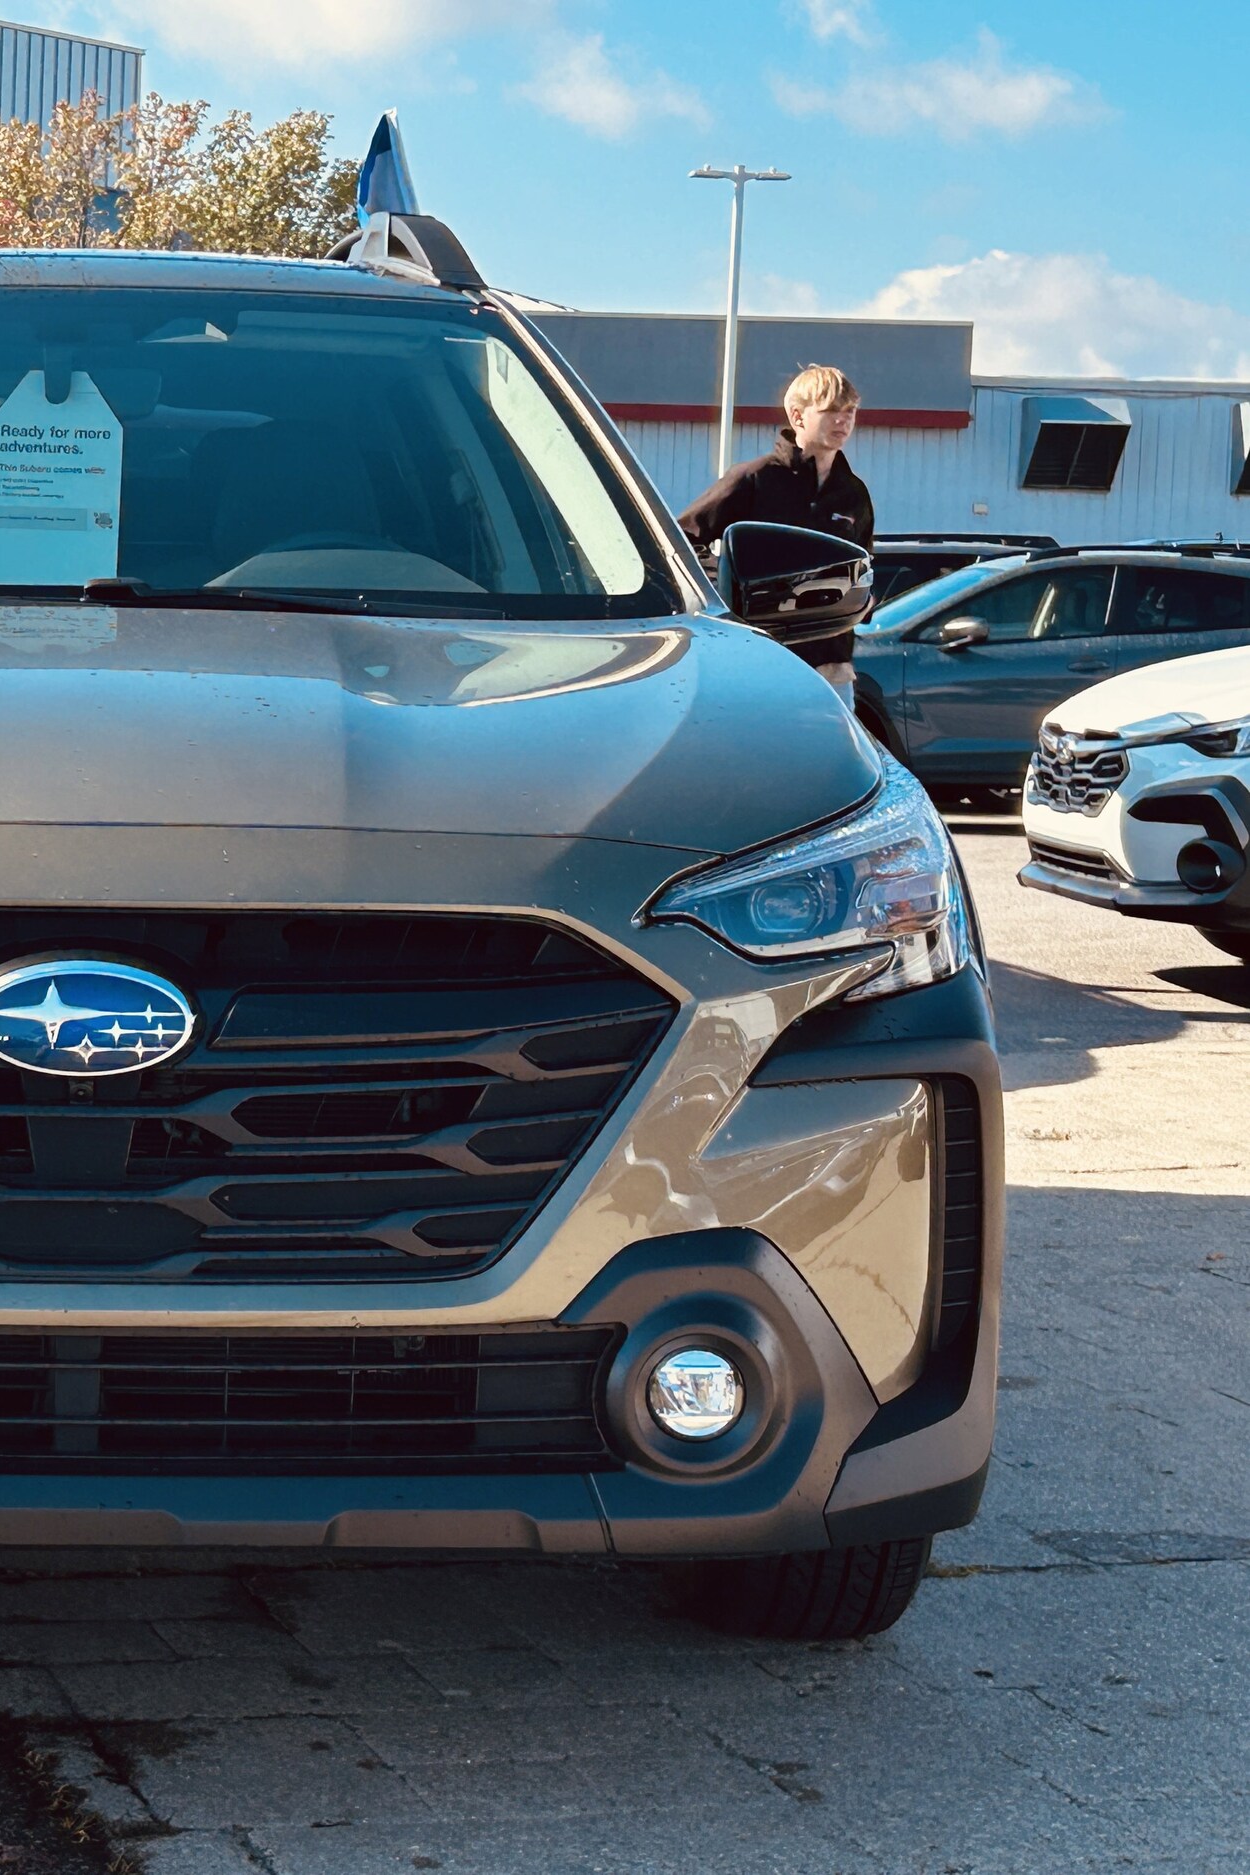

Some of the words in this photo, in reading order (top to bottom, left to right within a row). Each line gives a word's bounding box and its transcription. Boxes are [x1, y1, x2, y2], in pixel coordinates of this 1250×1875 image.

[0, 424, 45, 440] Ready
[50, 426, 70, 438] for
[74, 428, 111, 440] more
[0, 440, 84, 455] adventures.
[20, 464, 51, 473] Subaru
